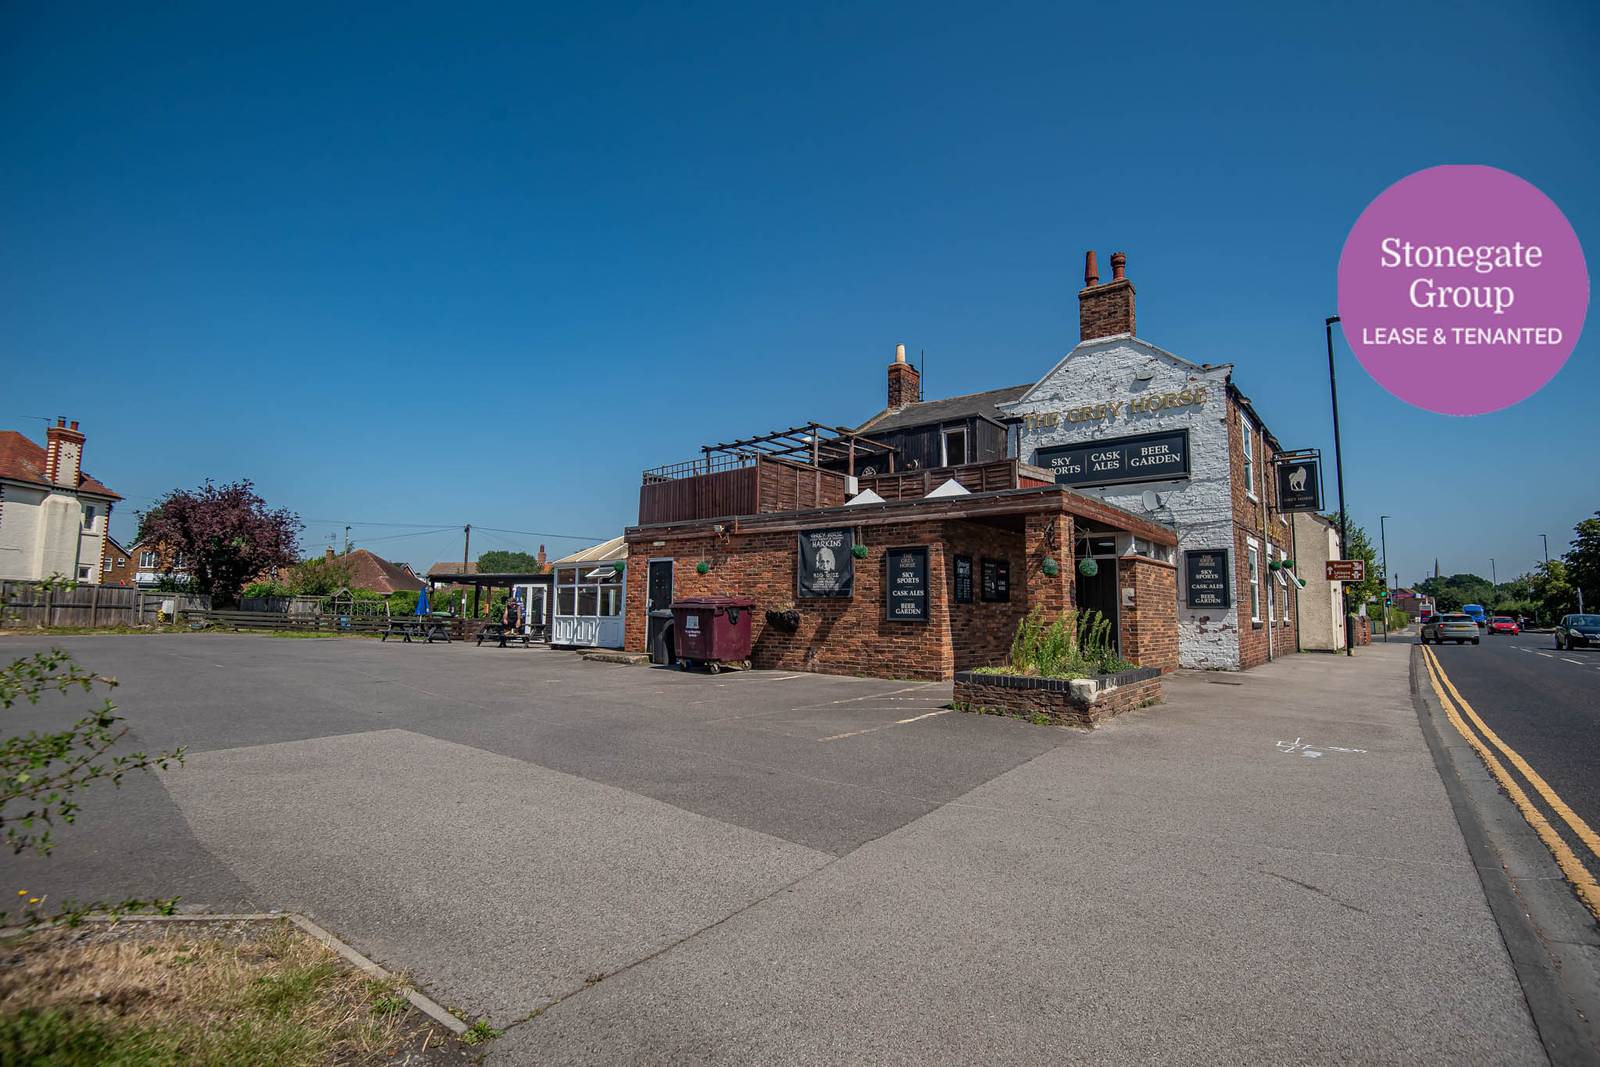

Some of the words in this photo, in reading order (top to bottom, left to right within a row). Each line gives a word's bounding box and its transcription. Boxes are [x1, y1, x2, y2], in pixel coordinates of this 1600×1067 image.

[1024, 411, 1060, 432] THE
[1067, 401, 1124, 424] GREY
[1130, 387, 1208, 414] HORSE
[1091, 450, 1121, 462] CASK
[1141, 445, 1170, 456] BEER
[1051, 456, 1072, 467] SKY
[1093, 460, 1120, 471] ALES
[1130, 453, 1181, 467] GARDEN
